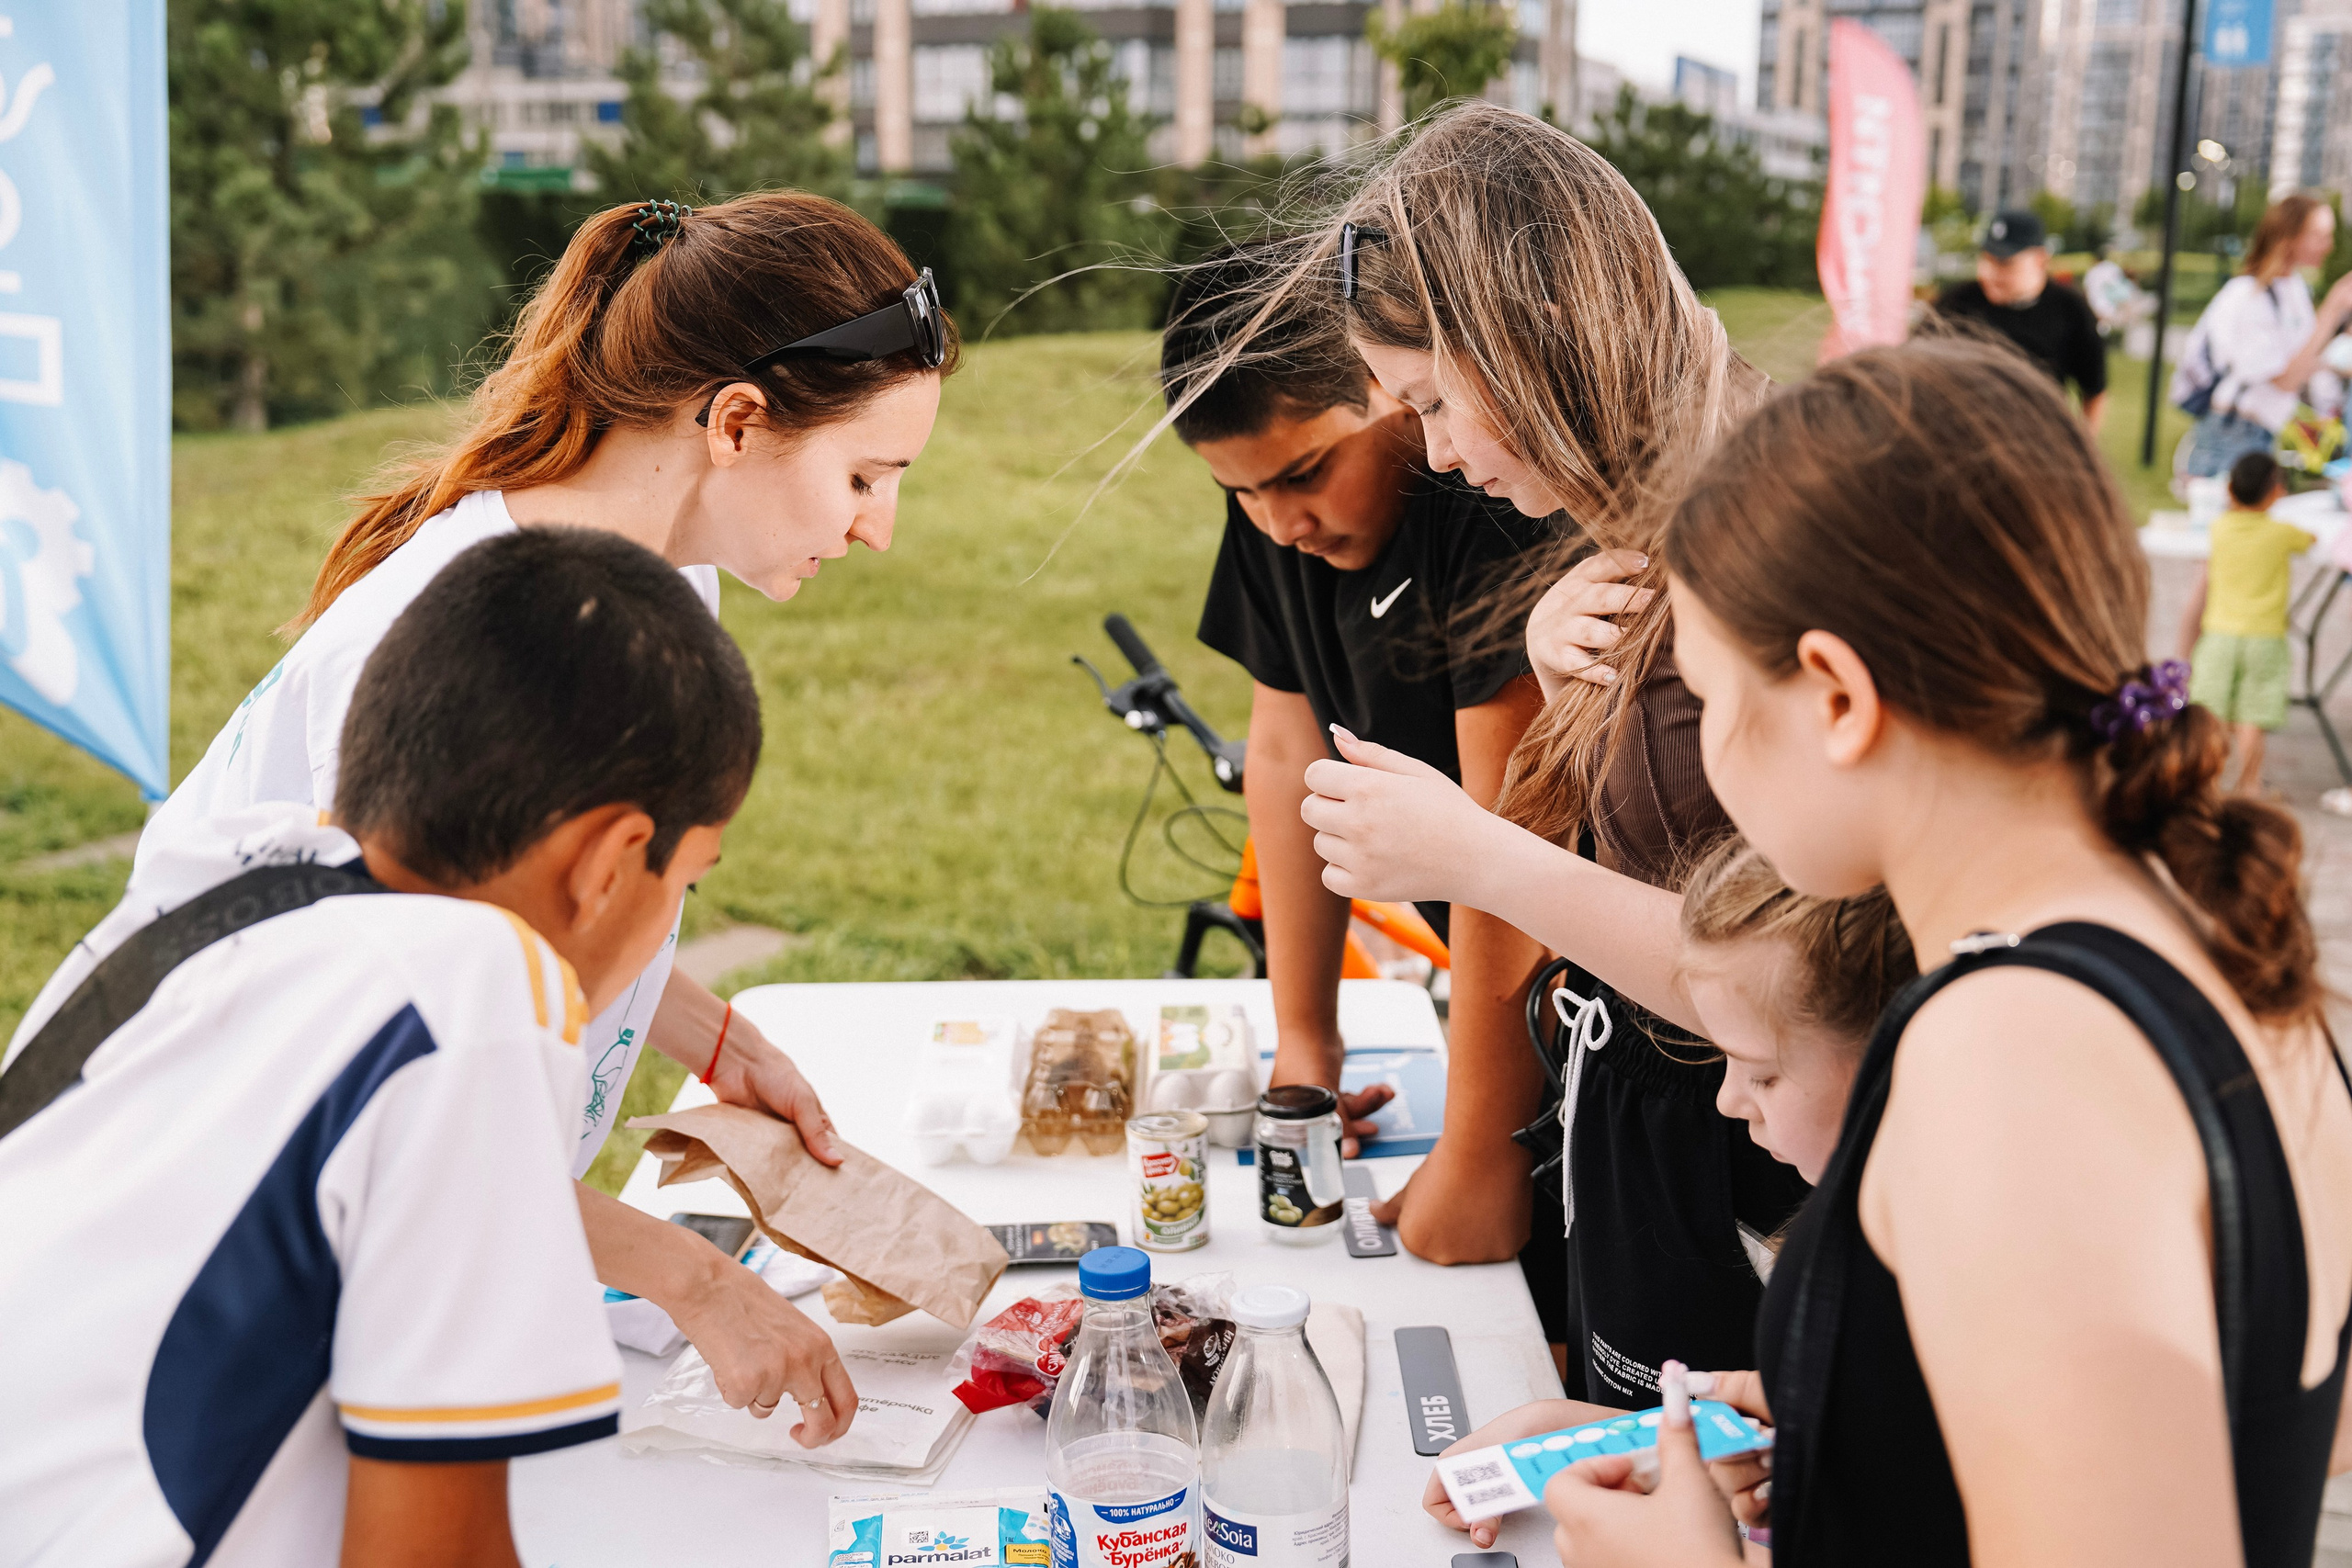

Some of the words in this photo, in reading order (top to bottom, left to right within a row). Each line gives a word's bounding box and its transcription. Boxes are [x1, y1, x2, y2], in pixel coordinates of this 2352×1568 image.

[1600, 1338, 1612, 1353] PANTS
[1611, 1349, 1622, 1360] ARE
[1622, 1356, 1650, 1374] COLORED
[1650, 1368, 1663, 1378] WIT
[1603, 1373, 1622, 1392] COTTON
[1622, 1387, 1634, 1396] MIX
[1606, 1359, 1614, 1371] THE
[1614, 1367, 1636, 1383] FABRIC
[1637, 1378, 1645, 1387] IS
[1622, 1364, 1653, 1382] CREATED
[858, 1396, 934, 1415] ятёрочка
[1419, 1394, 1458, 1442] ХЛЕБ
[1110, 1508, 1130, 1517] 100%
[1131, 1498, 1174, 1517] НАТУРАЛЬНО
[1097, 1522, 1187, 1551] Кубанская
[888, 1546, 992, 1566] parmalat
[1108, 1541, 1180, 1568] Бурёнка
[1204, 1540, 1235, 1564] ОЛОКО
